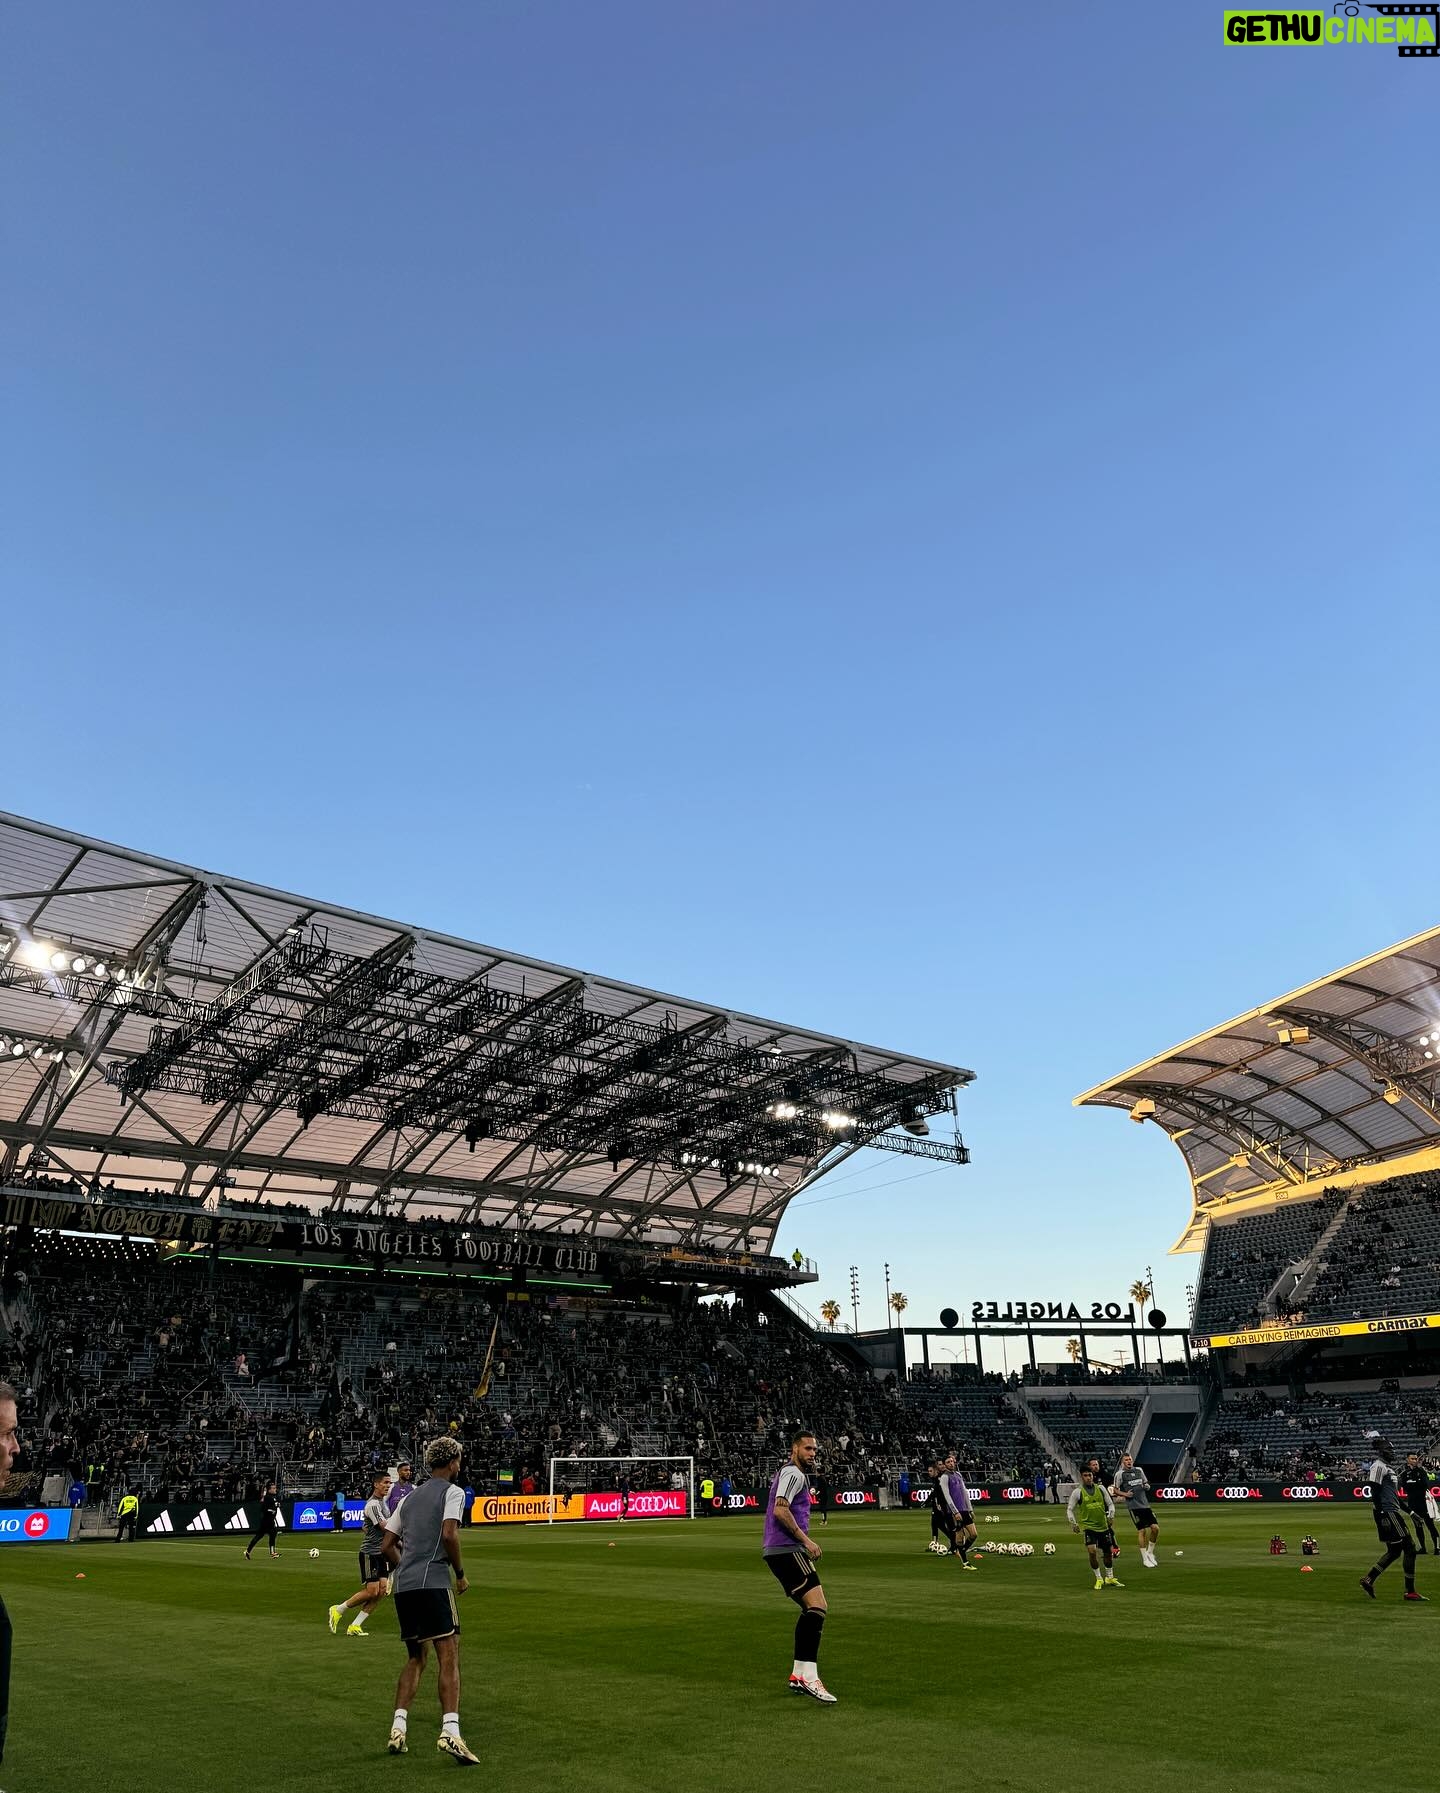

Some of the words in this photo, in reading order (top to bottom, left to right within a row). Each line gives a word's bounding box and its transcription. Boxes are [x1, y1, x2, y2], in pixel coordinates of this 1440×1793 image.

[301, 1224, 341, 1246] LOS
[352, 1229, 442, 1256] ANGELES
[454, 1238, 544, 1267] FOOTBALL
[555, 1248, 598, 1272] CLUB
[1228, 1335, 1248, 1346] CAR
[1248, 1331, 1283, 1343] BUYING
[1284, 1326, 1341, 1340] REIMAGINED
[483, 1498, 558, 1520] Continental
[589, 1498, 621, 1512] Audi
